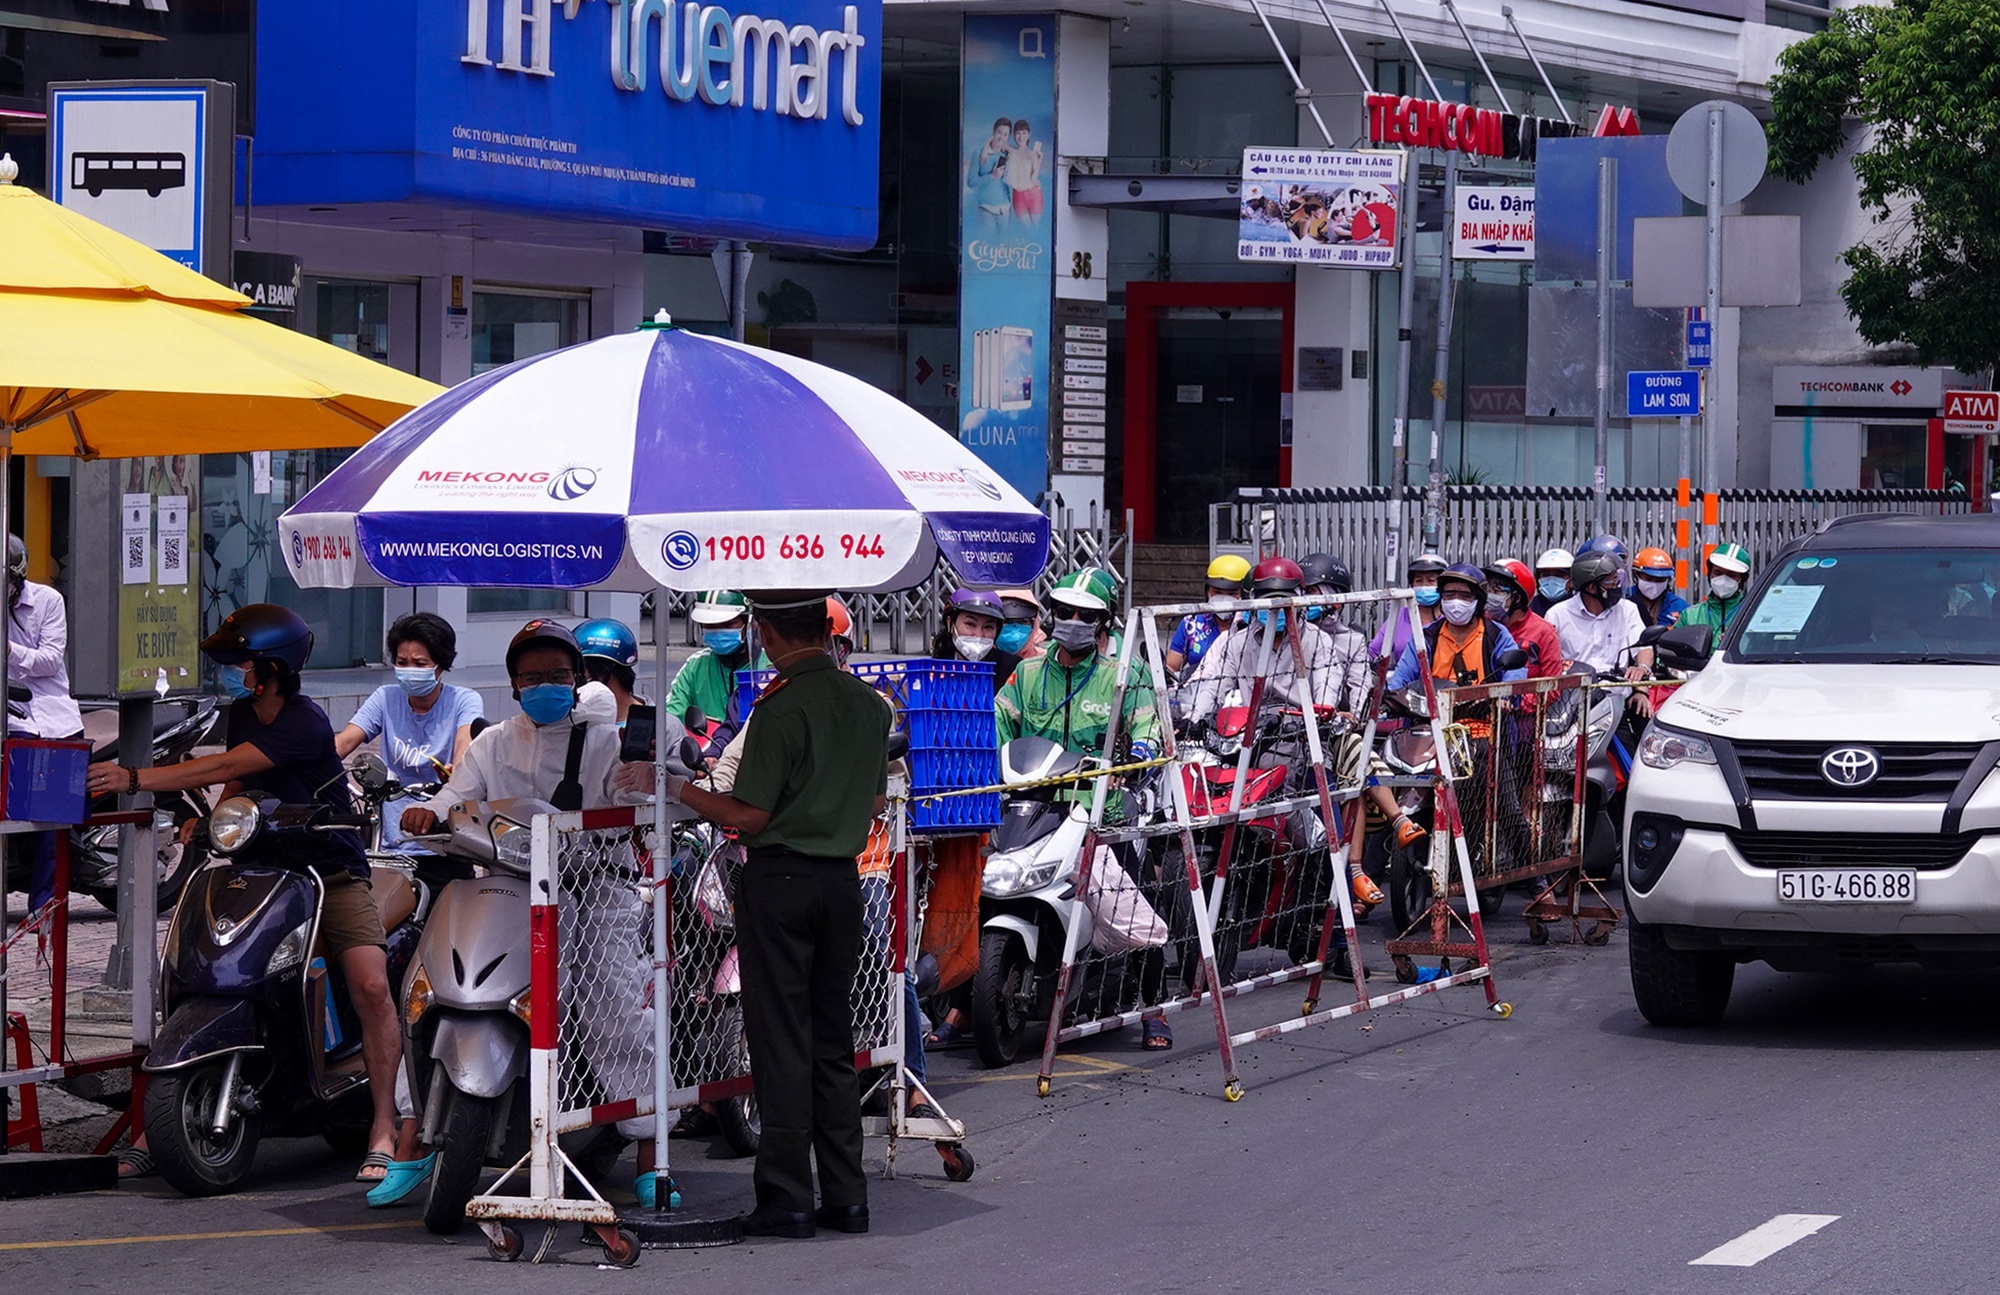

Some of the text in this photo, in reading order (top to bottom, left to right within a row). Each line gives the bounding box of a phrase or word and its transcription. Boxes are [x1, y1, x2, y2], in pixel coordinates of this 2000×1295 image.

[472, 129, 482, 141] TY
[481, 150, 488, 162] 36
[1275, 154, 1295, 165] LẠC
[1298, 154, 1312, 165] BỘ
[1317, 155, 1341, 164] TDTT
[1345, 156, 1362, 165] CHI
[1468, 194, 1535, 216] Gu. Đậm
[1461, 214, 1534, 246] BIA NHẬP KHẨ
[1259, 246, 1276, 257] GYM
[1283, 247, 1303, 259] YOGA
[1309, 248, 1333, 260] MUAY
[1338, 249, 1359, 261] JUDO
[1364, 250, 1392, 262] HIPHOP
[1071, 251, 1092, 280] 36
[254, 282, 266, 304] A
[268, 284, 296, 307] BANK
[1645, 374, 1682, 387] ĐƯỜNG
[1800, 382, 1884, 393] TECHCOMBANK
[1643, 392, 1690, 408] LAM SƠN
[1948, 397, 1995, 417] ATM
[1947, 422, 1984, 430] TECHCOMBANK
[967, 426, 1017, 446] LUNA
[417, 470, 551, 484] MEKONG
[897, 470, 966, 483] MEKONG
[379, 542, 603, 560] WWW.MEKONGLOGISTICS.VN
[704, 533, 885, 562] 1900 636 944
[136, 625, 177, 659] XE BUÝT
[1675, 700, 1729, 723] FORTUNER
[1781, 873, 1911, 899] 51G-466.88
[280, 968, 298, 983] SYM
